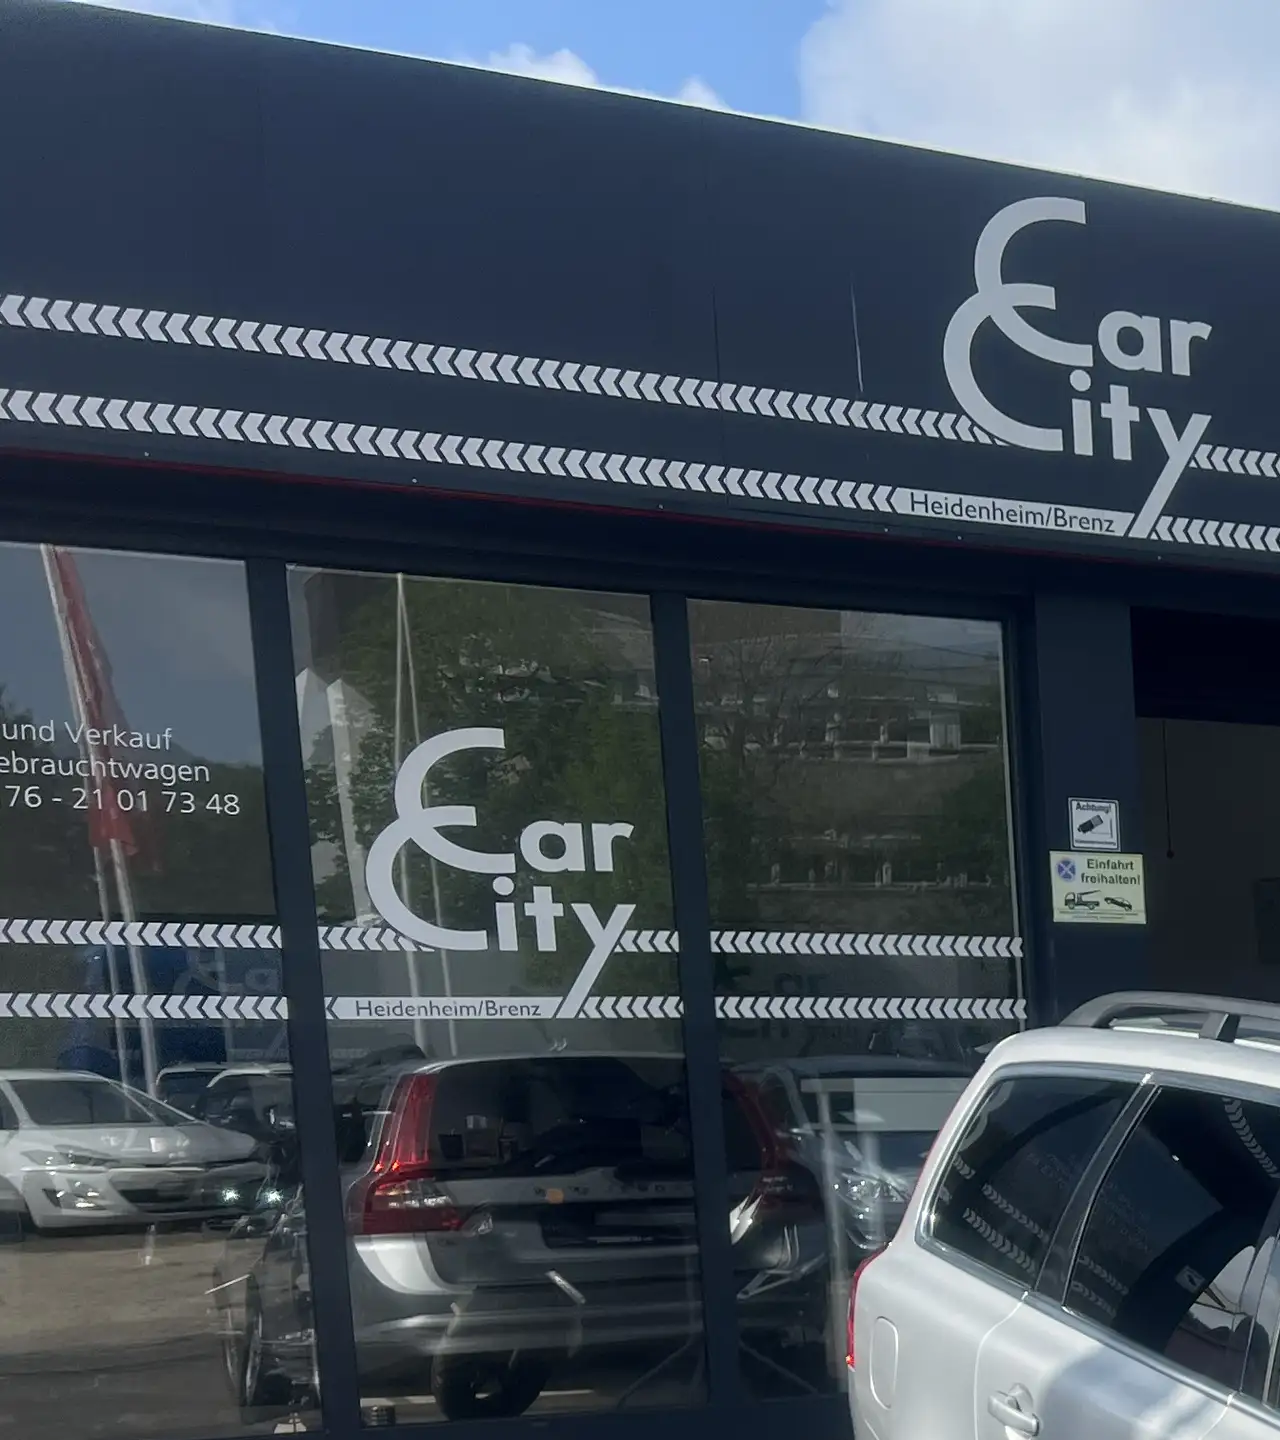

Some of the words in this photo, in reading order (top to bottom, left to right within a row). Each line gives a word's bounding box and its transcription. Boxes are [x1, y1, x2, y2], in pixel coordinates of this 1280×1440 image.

[909, 491, 1116, 534] Heidenheim/Brenz
[2, 720, 55, 742] und
[64, 721, 172, 750] Verkauf
[72, 787, 103, 810] 21
[117, 789, 147, 812] 01
[161, 791, 196, 813] 73
[205, 793, 241, 815] 48
[1087, 859, 1134, 870] Einfahrt
[1081, 873, 1140, 885] freihalten!
[355, 1000, 541, 1018] Heidenheim/Brenz
